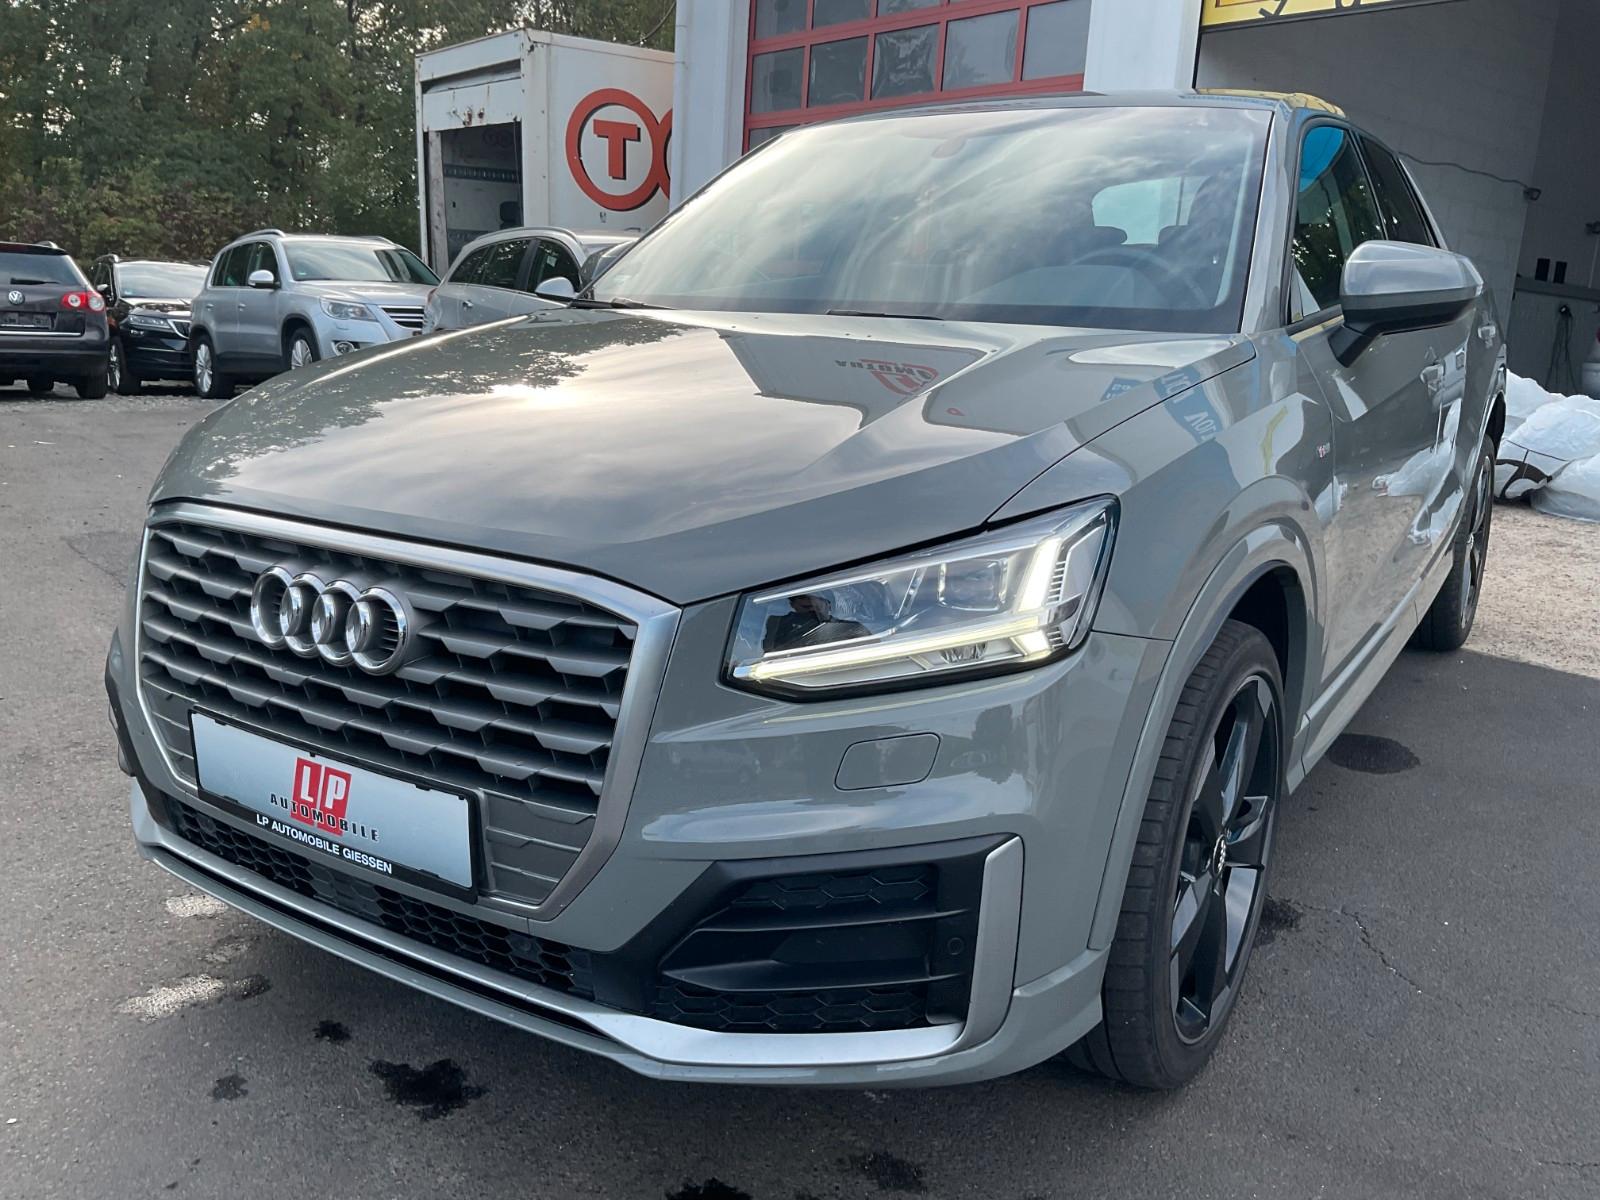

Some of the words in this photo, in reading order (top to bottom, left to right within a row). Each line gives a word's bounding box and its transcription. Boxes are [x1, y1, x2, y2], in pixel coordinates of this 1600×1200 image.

[300, 765, 347, 809] LP
[270, 793, 380, 841] AUTOMOBILE
[256, 813, 269, 826] LP
[271, 821, 341, 855] AUTOMOBILE
[343, 848, 392, 874] GIESSEN
